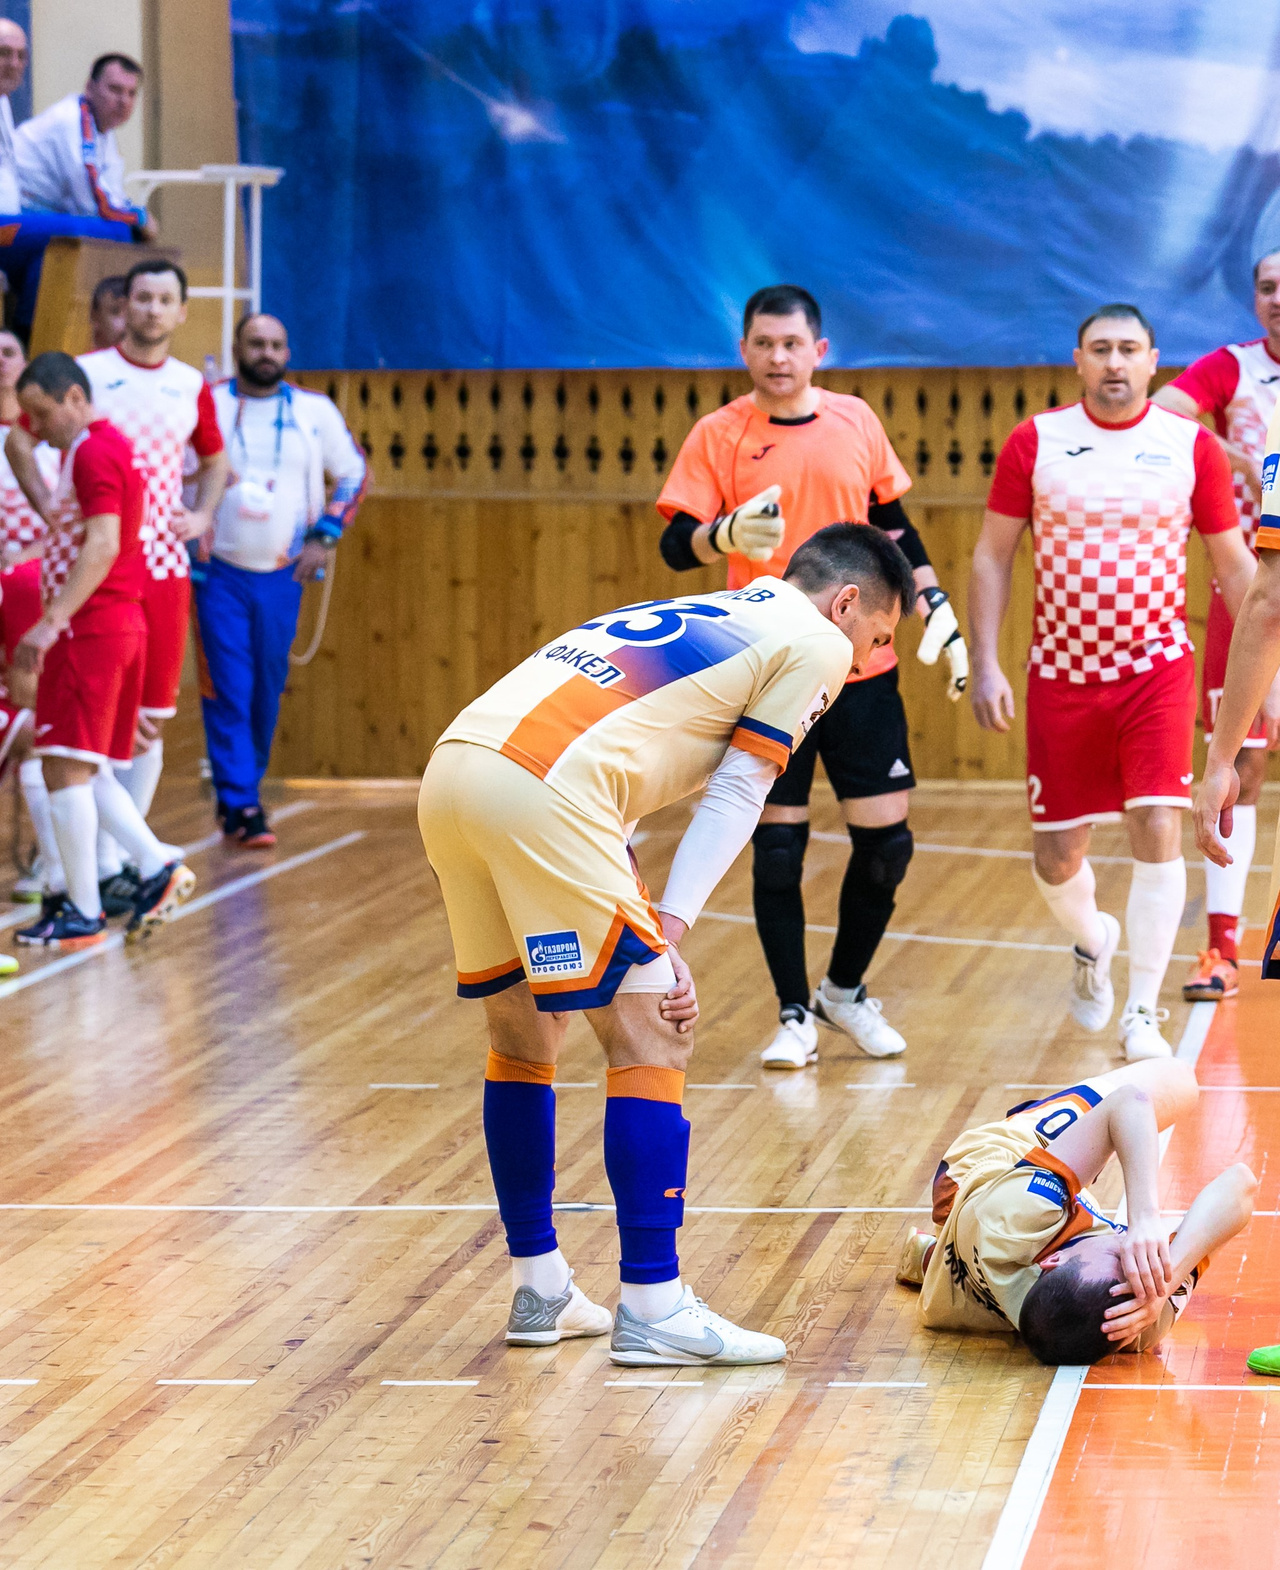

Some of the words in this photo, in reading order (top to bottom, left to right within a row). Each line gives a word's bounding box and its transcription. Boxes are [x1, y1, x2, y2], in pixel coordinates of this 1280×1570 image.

[545, 644, 622, 685] ФАКЕЛ
[543, 942, 578, 955] ГАЗПРОМ
[531, 962, 583, 974] ПРОФСОЮЗ
